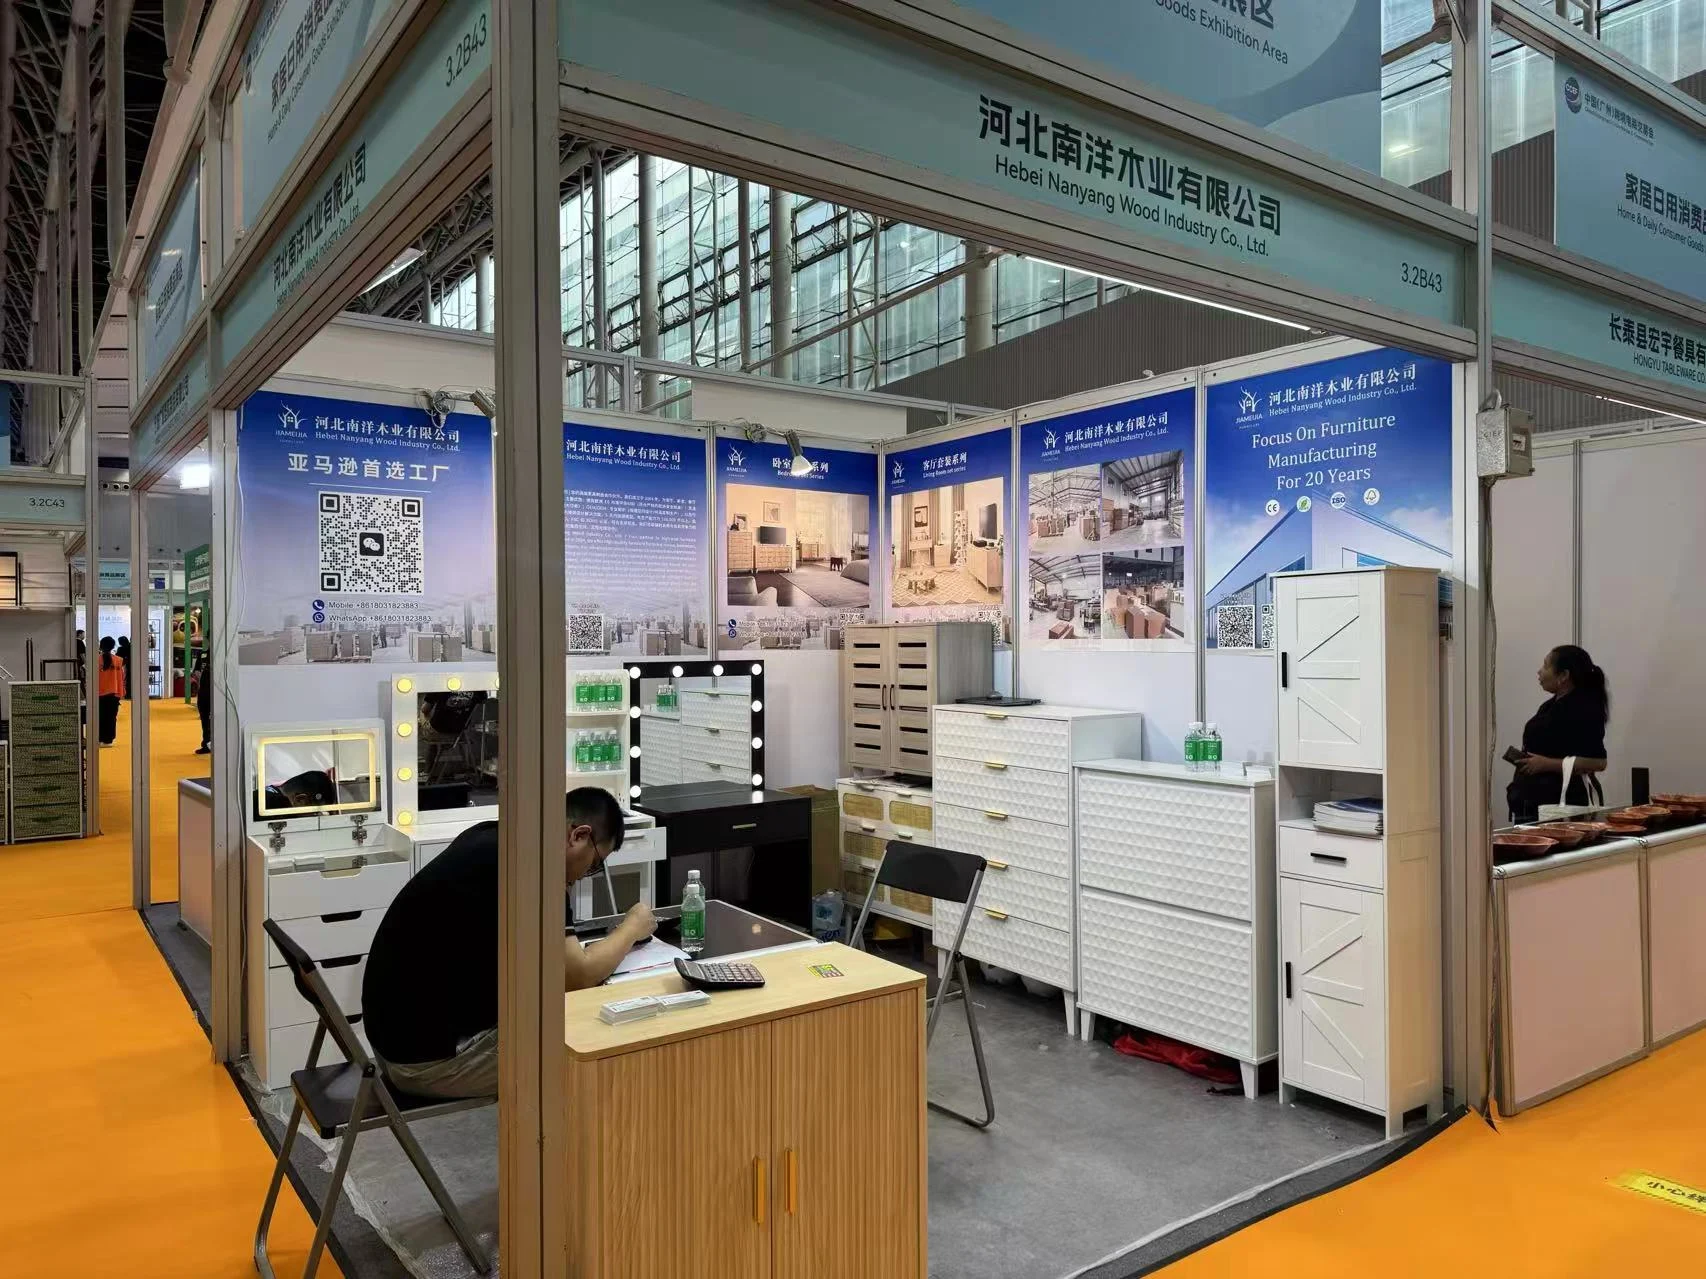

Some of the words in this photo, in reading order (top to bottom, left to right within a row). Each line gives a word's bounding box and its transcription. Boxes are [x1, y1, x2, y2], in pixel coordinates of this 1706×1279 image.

[445, 12, 487, 88] 3.2B43
[1199, 10, 1261, 51] Exhibition
[1262, 40, 1289, 64] Area
[978, 94, 1282, 236] 河北南洋木业有限公司
[273, 141, 367, 293] 河北南洋木业有限公司
[994, 153, 1044, 187] Hebei
[1047, 170, 1116, 214] Nanyang
[1118, 193, 1161, 222] Wood
[1163, 205, 1218, 245] Industry
[1220, 226, 1244, 251] Co.,
[1246, 234, 1270, 257] Ltd.
[1616, 203, 1636, 222] Home
[1643, 215, 1658, 235] Daily
[1658, 222, 1687, 245] Consumer
[1686, 235, 1705, 253] Goods
[1401, 262, 1442, 293] 3.2B43
[1633, 352, 1661, 372] HONGYU
[1661, 360, 1697, 382] TABLEWARE
[1268, 363, 1417, 407] 河北南洋木业有限公司
[1268, 404, 1290, 418] Hebei
[1290, 398, 1324, 414] Nanyang
[1324, 395, 1348, 407] Wood
[1348, 388, 1383, 404] Industry
[1384, 386, 1400, 398] Co.,
[1400, 381, 1418, 394] Ltd.
[314, 414, 461, 444] 河北南洋木业有限公司
[315, 431, 339, 441] Hebei
[340, 433, 375, 446] Nanyang
[375, 437, 398, 447] Wood
[399, 438, 431, 450] Industry
[446, 443, 461, 453] Ltd.
[1064, 411, 1169, 444] 河北南洋木业有限公司
[1103, 437, 1120, 446] Wood
[1120, 433, 1144, 443] Industry
[1251, 431, 1293, 449] Focus
[1295, 425, 1317, 442] On
[1320, 413, 1397, 438] Furniture
[566, 438, 681, 464] 河北南洋木业有限公司
[613, 457, 632, 466] Wood
[632, 458, 658, 470] Industry
[772, 457, 829, 473] 卧室系列
[1267, 440, 1378, 470] Manufacturing
[287, 452, 450, 483] 亚马逊首选工厂
[1276, 475, 1302, 491] For
[1305, 469, 1325, 487] 20
[1327, 466, 1372, 485] Years
[29, 497, 66, 509] 3.2C43
[328, 601, 354, 610] Mobile
[328, 613, 369, 624] WhatsApp
